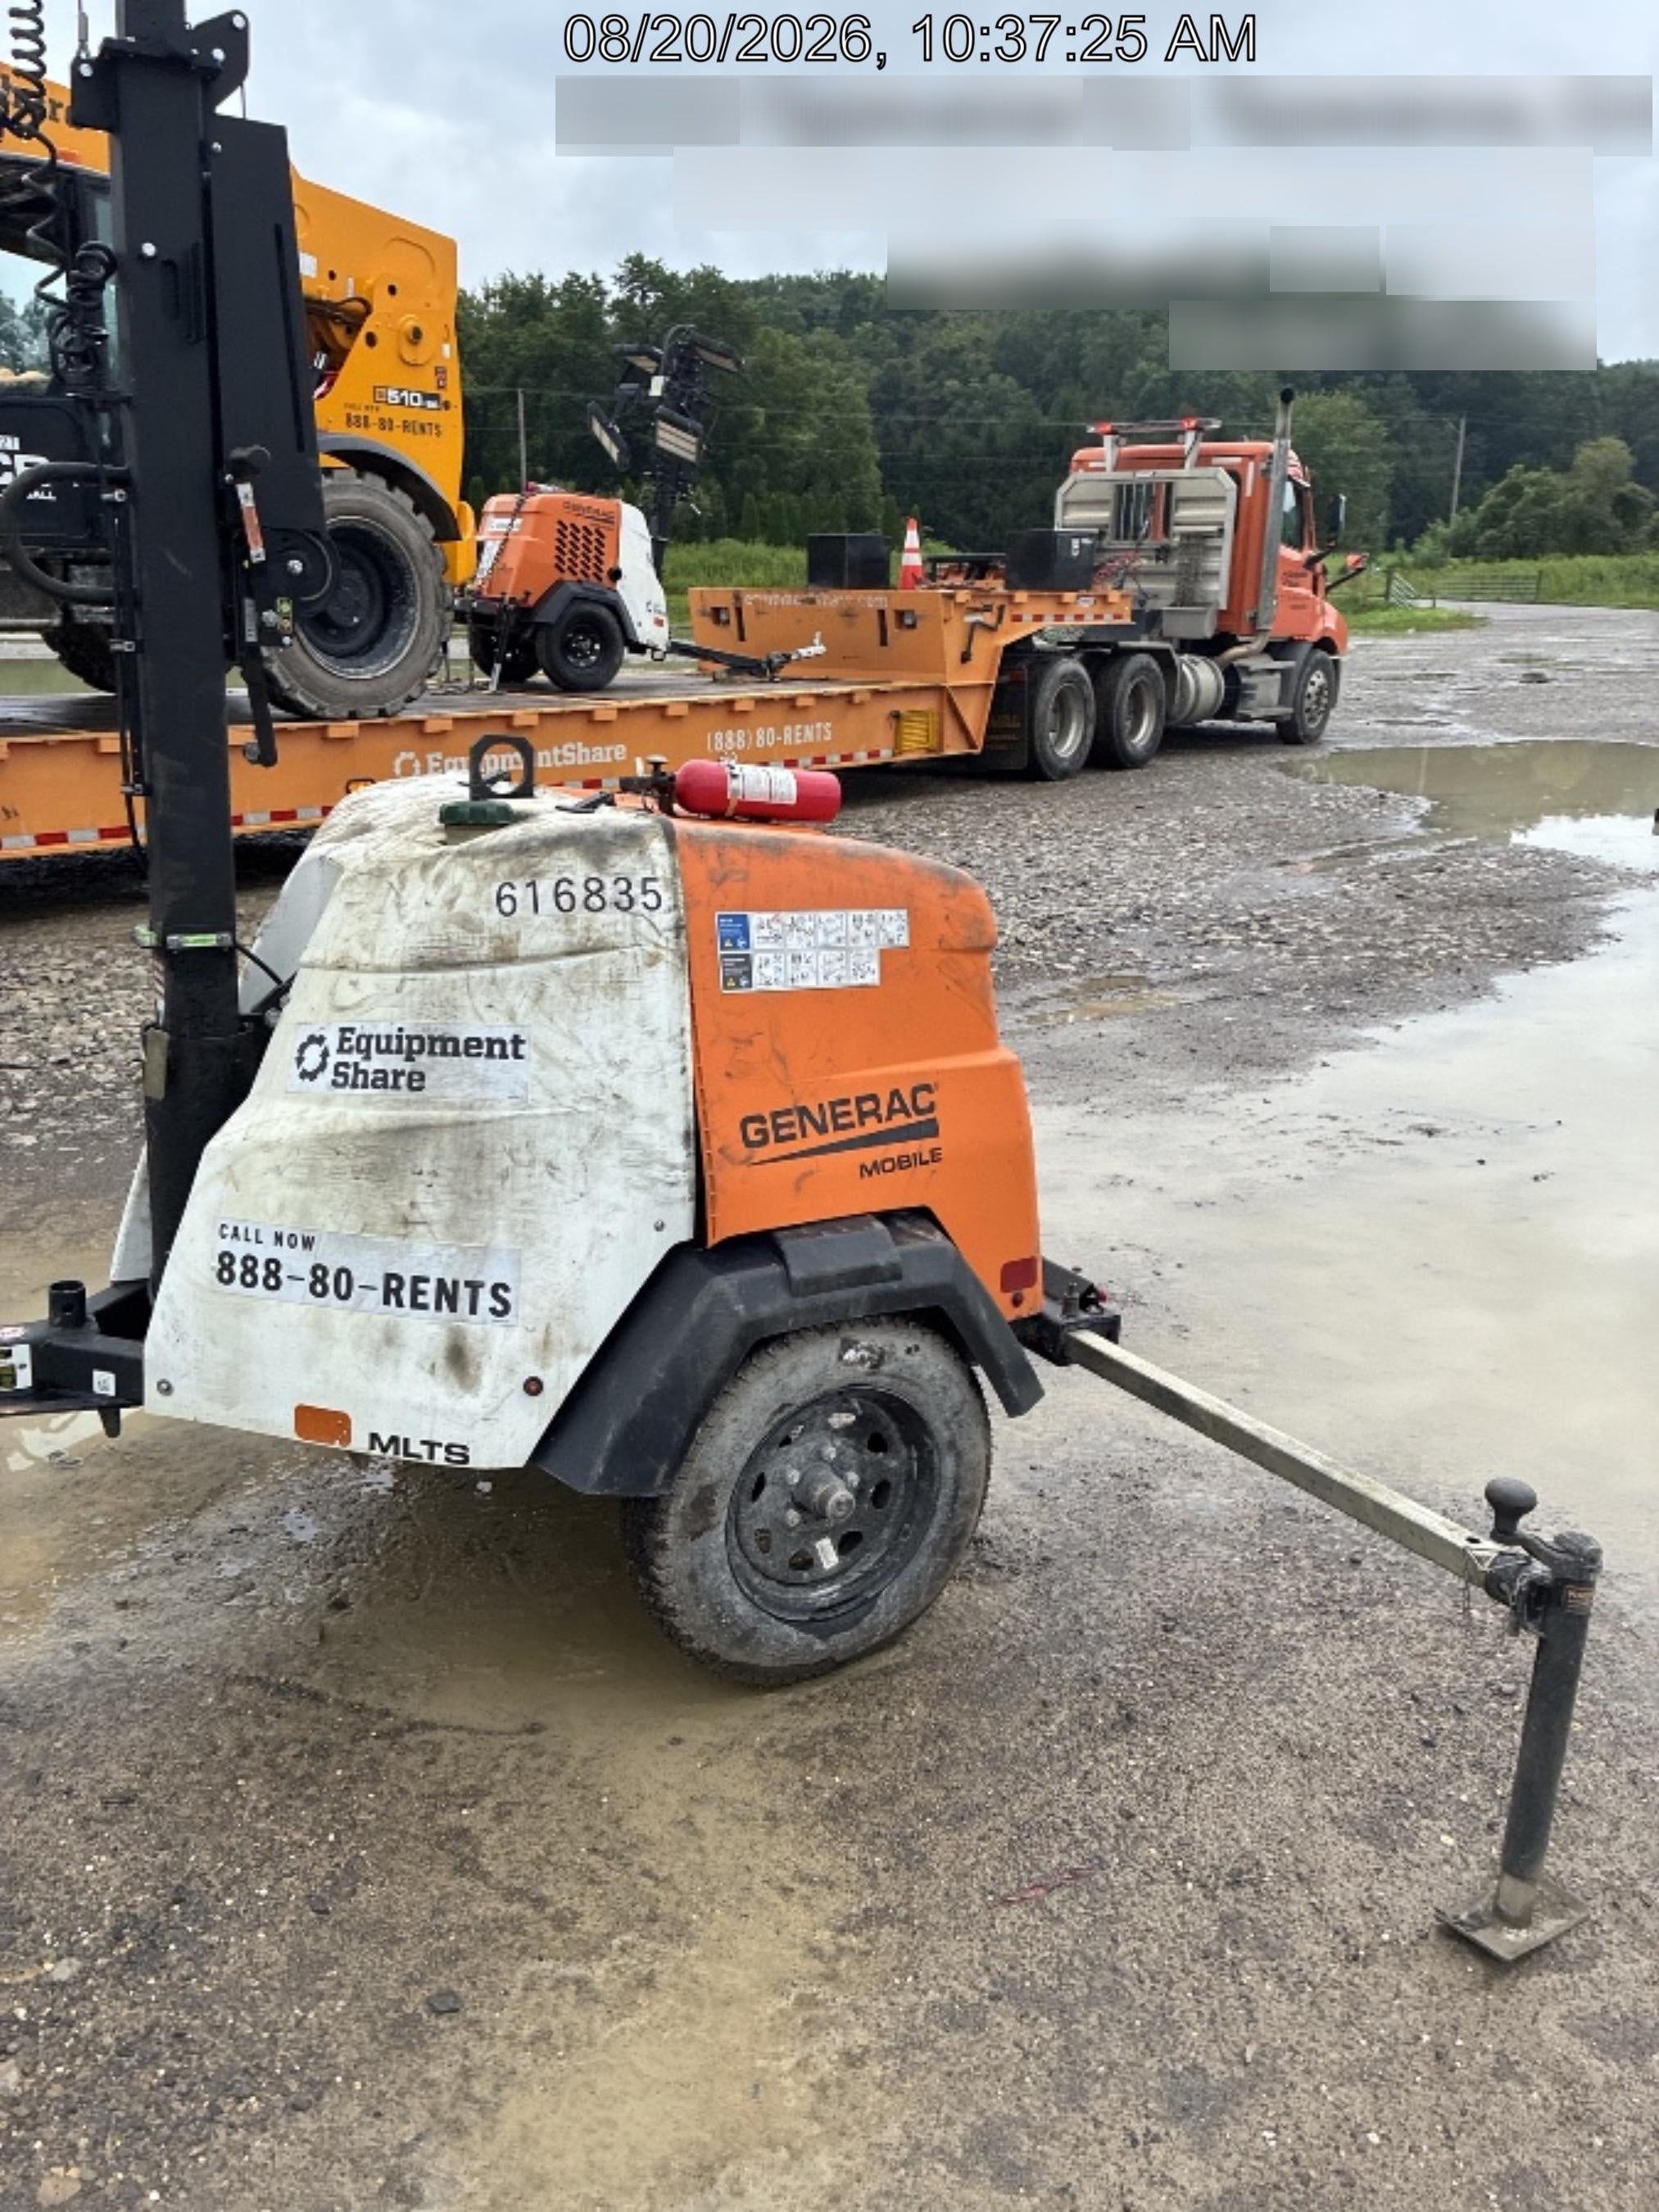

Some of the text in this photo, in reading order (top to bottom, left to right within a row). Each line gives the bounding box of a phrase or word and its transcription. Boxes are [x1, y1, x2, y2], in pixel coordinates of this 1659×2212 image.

[346, 412, 442, 437] 888-80-RENTS
[707, 722, 832, 752] (888) 80-RENTS
[496, 877, 662, 917] 616835
[336, 1027, 527, 1063] Equipment
[331, 1061, 426, 1091] Share
[740, 1082, 936, 1149] GENERAC
[859, 1146, 943, 1180] MOBILE
[218, 1222, 316, 1252] CALL NOW
[215, 1250, 512, 1318] 888-80-RENTS
[369, 1431, 470, 1465] MLTS
